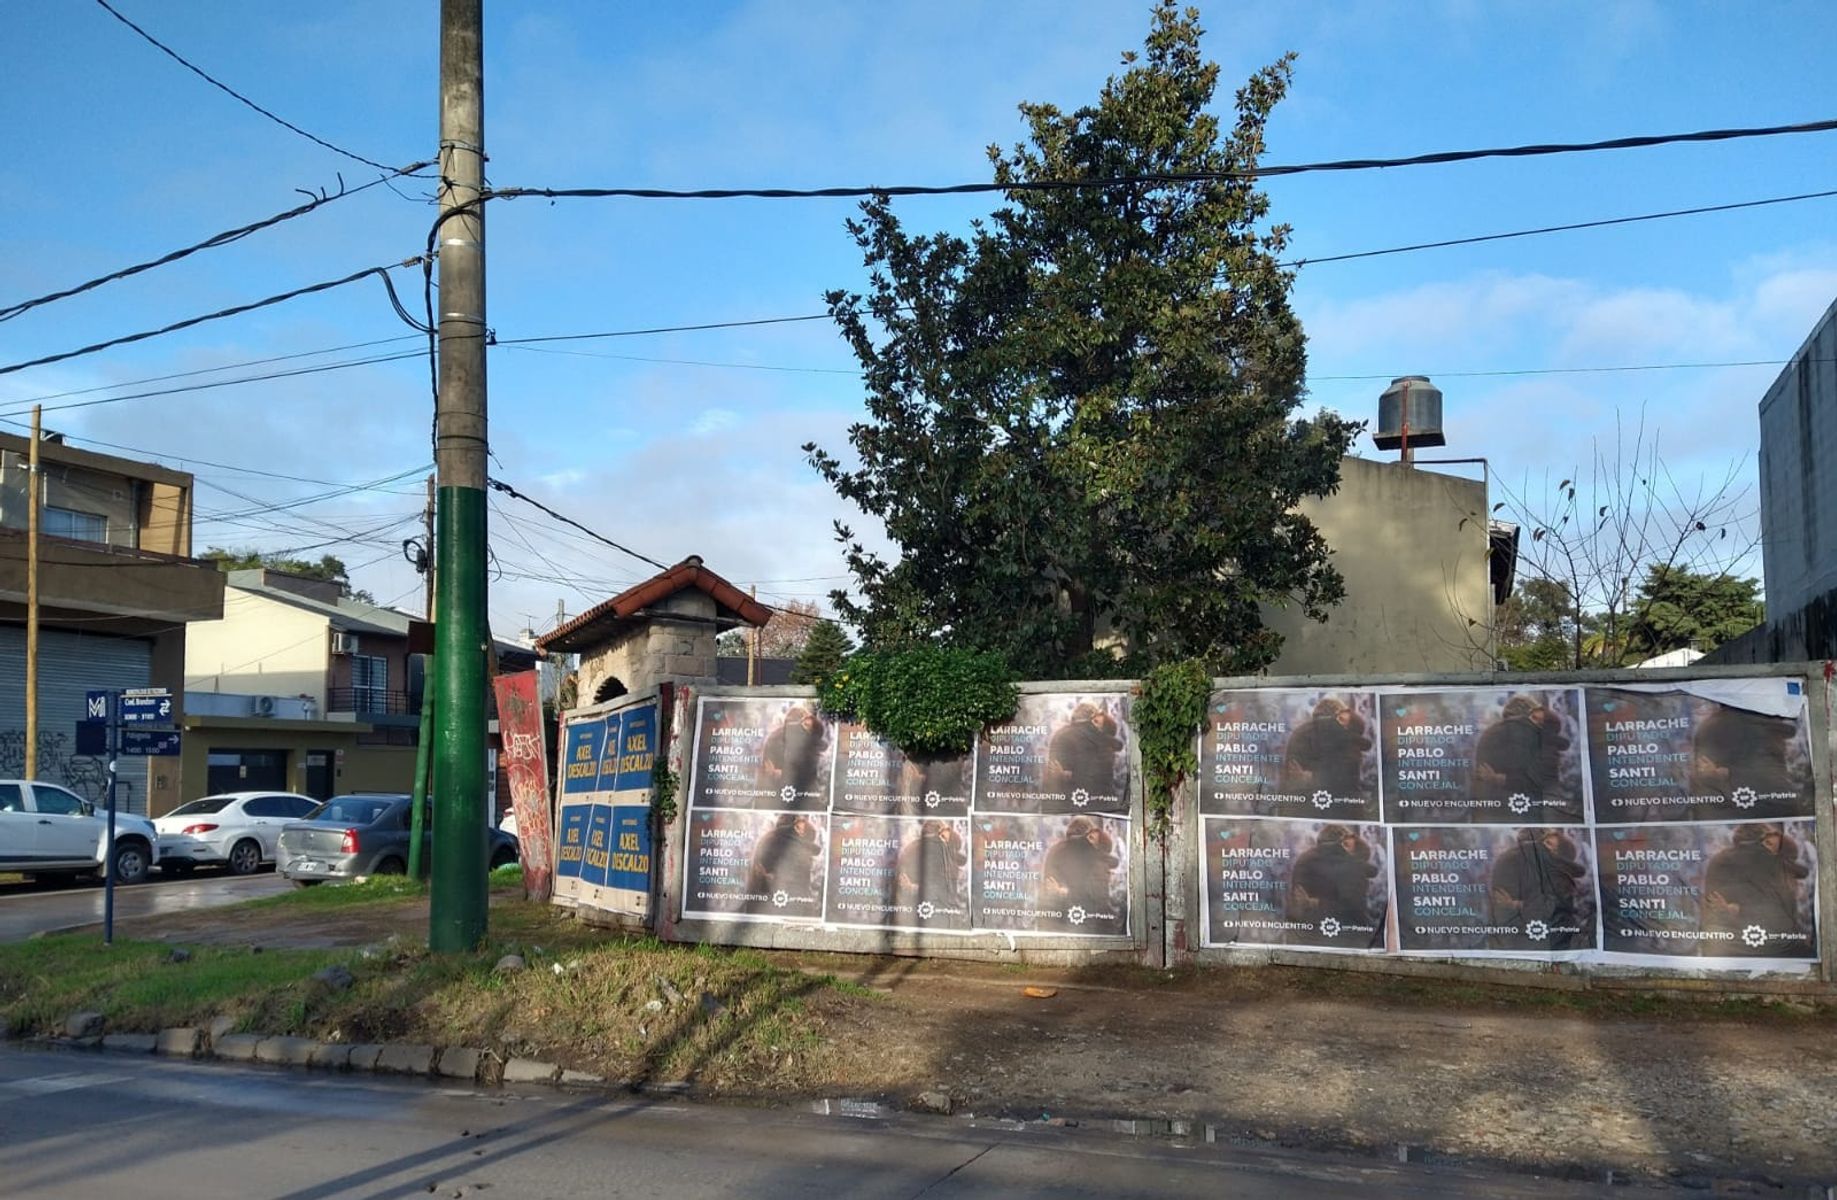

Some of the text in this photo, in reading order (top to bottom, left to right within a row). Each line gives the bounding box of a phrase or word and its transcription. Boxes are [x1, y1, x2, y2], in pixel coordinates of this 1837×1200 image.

[1217, 722, 1286, 732] LARRACHE
[1605, 717, 1689, 733] LARRACHE
[712, 728, 764, 737] LARRACHE
[991, 726, 1047, 735] LARRACHE
[1398, 725, 1474, 736] LARRACHE
[1217, 732, 1268, 740] DIPUTADO
[1398, 736, 1455, 744] DIPUTADO
[1606, 731, 1670, 742] DIPUTADO
[627, 734, 647, 752] AXEL
[710, 746, 742, 755] PABLO
[990, 745, 1024, 754] PABLO
[1216, 744, 1257, 753] PABLO
[1608, 743, 1658, 756] PABLO
[849, 751, 884, 759] PABLO
[1216, 754, 1280, 762] INTENDENTE
[1398, 749, 1444, 758] PABLO
[1398, 759, 1470, 767] INTENDENTE
[1608, 752, 1688, 765] INTENDENTE
[708, 765, 738, 773] SANTI
[847, 769, 878, 778] SANTI
[989, 766, 1020, 774] SANTI
[1215, 765, 1253, 774] SANTI
[1609, 766, 1655, 779] SANTI
[989, 775, 1034, 783] CONCEJAL
[1215, 775, 1269, 784] CONCEJAL
[1399, 770, 1440, 780] SANTI
[1399, 781, 1460, 790] CONCEJAL
[1610, 777, 1677, 788] CONCEJAL
[738, 789, 776, 797] ENCUENTRO
[1022, 792, 1065, 800] ENCUENTRO
[1256, 795, 1306, 803] ENCUENTRO
[1625, 796, 1724, 807] NUEVO ENCUENTRO
[1444, 800, 1501, 808] ENCUENTRO
[702, 829, 755, 838] LARRACHE
[619, 833, 639, 851] AXEL
[842, 838, 898, 848] LARRACHE
[985, 841, 1042, 850] LARRACHE
[701, 848, 732, 856] PABLO
[1222, 848, 1290, 858] LARRACHE
[1411, 850, 1488, 860] LARRACHE
[1615, 850, 1701, 861] LARRACHE
[841, 858, 875, 866] PABLO
[984, 861, 1019, 869] PABLO
[1411, 861, 1470, 870] DIPUTADO
[1617, 861, 1681, 871] DIPUTADO
[699, 868, 728, 876] SANTI
[840, 868, 894, 876] INTENDENTE
[984, 871, 1039, 879] INTENDENTE
[1222, 870, 1262, 879] PABLO
[699, 877, 740, 885] CONCEJAL
[840, 878, 870, 886] SANTI
[1412, 873, 1459, 883] PABLO
[1617, 874, 1669, 885] PABLO
[984, 881, 1014, 890] SANTI
[1223, 881, 1286, 889] INTENDENTE
[1413, 884, 1485, 893] INTENDENTE
[1619, 886, 1697, 895] INTENDENTE
[729, 893, 768, 901] ENCUENTRO
[984, 891, 1028, 900] CONCEJAL
[1223, 892, 1258, 902] SANTI
[1224, 902, 1275, 911] CONCEJAL
[1414, 897, 1456, 907] SANTI
[1620, 898, 1665, 909] SANTI
[847, 903, 912, 912] NUEVO ENCUENTRO
[1414, 907, 1476, 916] CONCEJAL
[1018, 910, 1062, 918] ENCUENTRO
[1620, 909, 1687, 920] CONCEJAL
[1262, 921, 1313, 930] ENCUENTRO
[1462, 927, 1518, 935] ENCUENTRO
[1634, 929, 1734, 940] NUEVO ENCUENTRO
